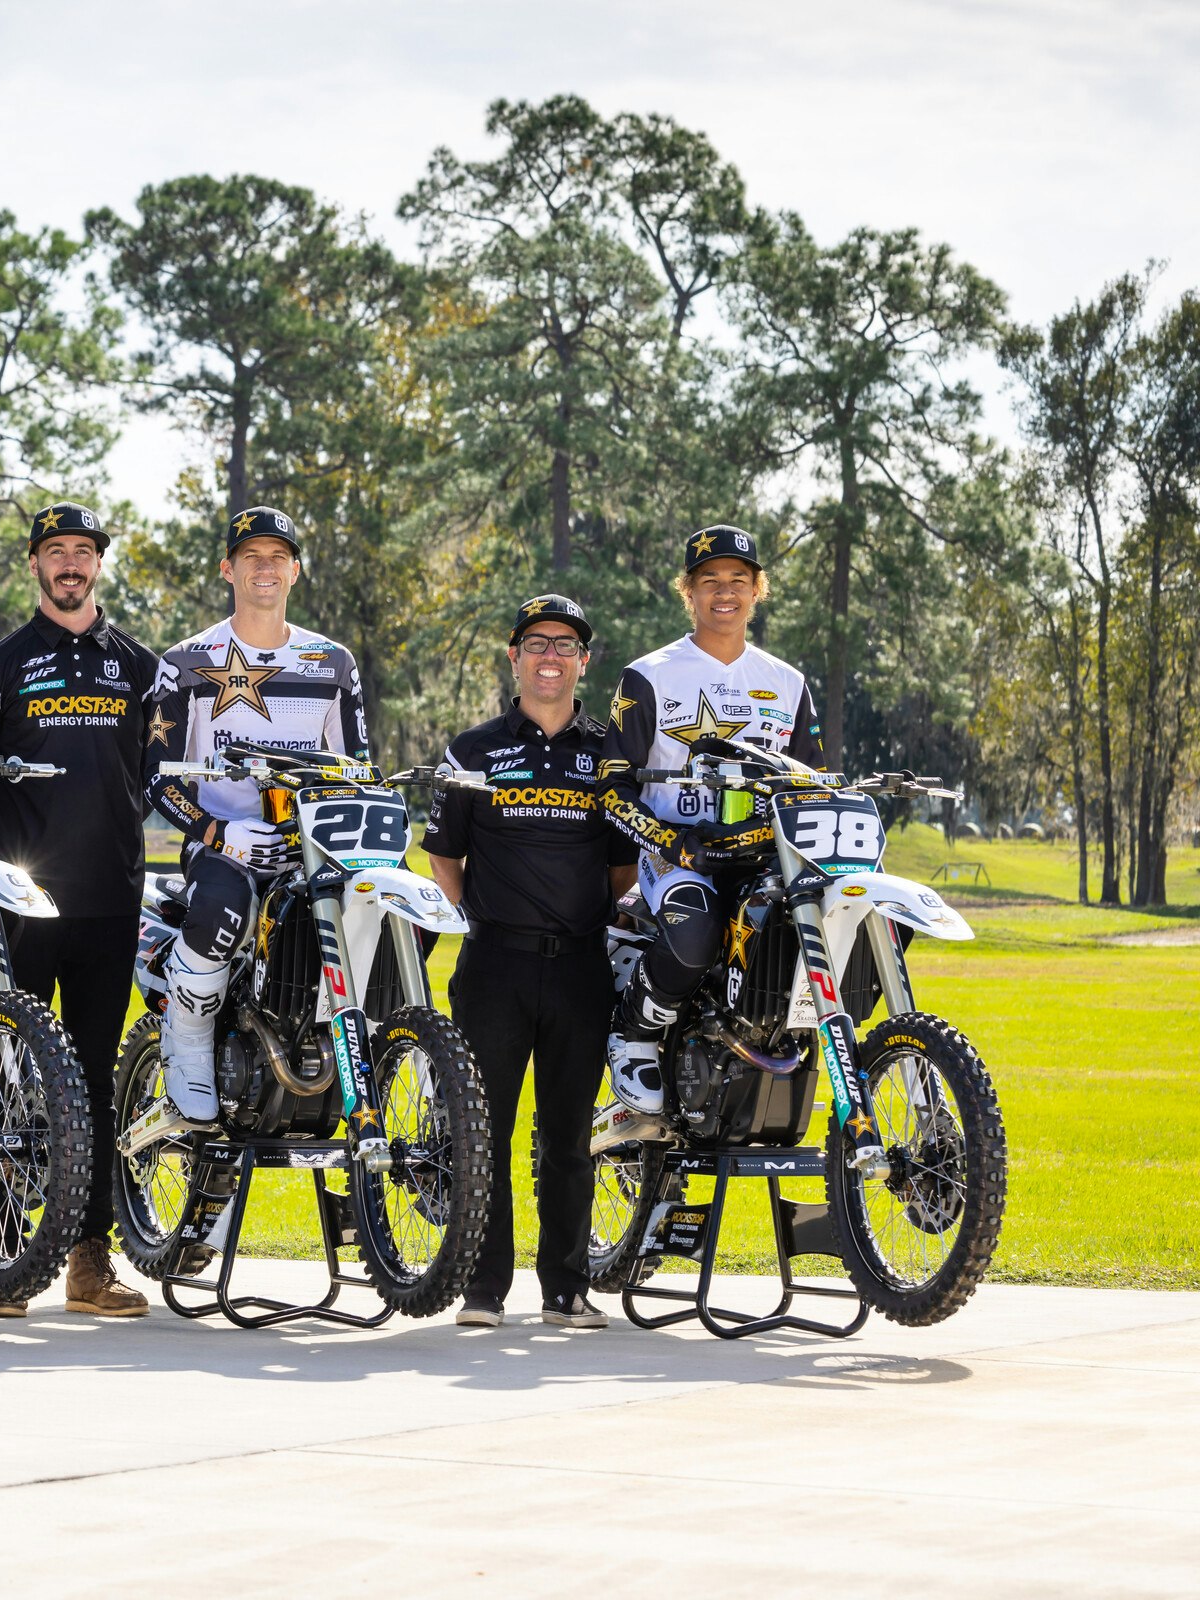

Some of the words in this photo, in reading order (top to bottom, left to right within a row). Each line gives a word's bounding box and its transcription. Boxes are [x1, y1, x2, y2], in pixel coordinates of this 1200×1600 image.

[24, 666, 57, 683] WP
[28, 681, 63, 691] MOTOREX
[27, 696, 127, 717] ROCKSTAR
[39, 716, 82, 728] ENERGY
[85, 716, 118, 727] DRINK
[490, 758, 526, 773] WP
[162, 784, 204, 822] ROCKSTAR
[492, 787, 597, 810] ROCKSTAR
[503, 808, 549, 818] ENERGY
[551, 809, 587, 820] DRINK
[311, 804, 407, 852] 28
[795, 810, 880, 859] 38
[208, 907, 243, 962] FOX
[389, 1028, 419, 1041] DUNLOP
[886, 1035, 926, 1052] DUNLOP
[334, 1038, 354, 1100] MOTOREX
[825, 1047, 848, 1107] MOTOREX
[671, 1212, 705, 1224] ROCKSTAR
